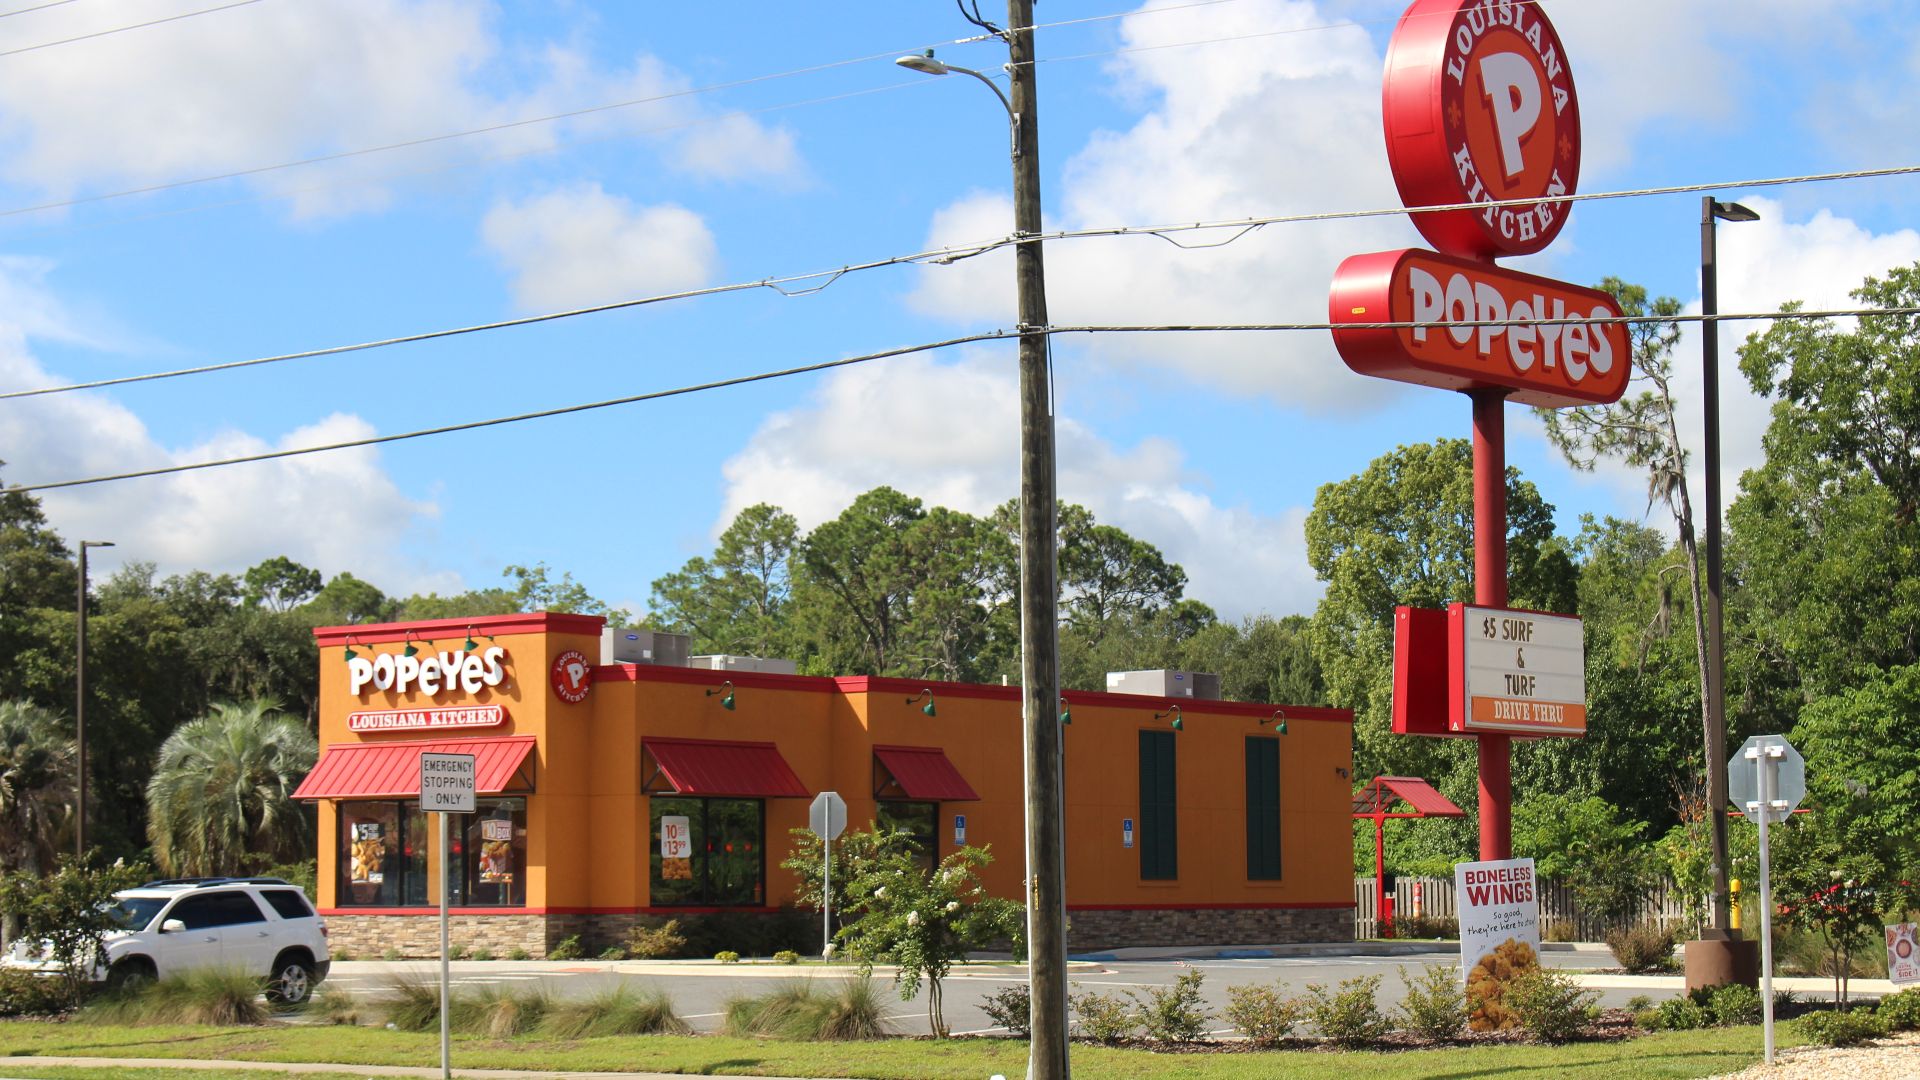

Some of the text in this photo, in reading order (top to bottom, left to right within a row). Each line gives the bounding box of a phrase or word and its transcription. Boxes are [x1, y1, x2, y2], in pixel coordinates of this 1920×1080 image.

[1448, 0, 1568, 116] LOUISIANA
[1479, 51, 1541, 177] P
[1453, 143, 1566, 242] KITCHEN
[1483, 617, 1534, 642] $5 SURF
[557, 652, 590, 673] LOUISIANA
[1517, 647, 1525, 669] &
[567, 662, 584, 689] P
[1504, 674, 1536, 697] TURF
[558, 683, 590, 702] KITCHEN
[351, 709, 497, 730] LOUISIANA KITCHEN
[1494, 701, 1564, 723] DRIVE THRU
[424, 760, 473, 773] EMERGENCY
[424, 776, 473, 789] STOPPING
[436, 792, 462, 805] ONLY
[665, 824, 678, 839] 10
[1465, 867, 1531, 885] BONELESS
[1466, 881, 1533, 907] WINGS
[1504, 907, 1523, 922] good,
[1467, 924, 1499, 937] they're
[1500, 922, 1516, 931] here
